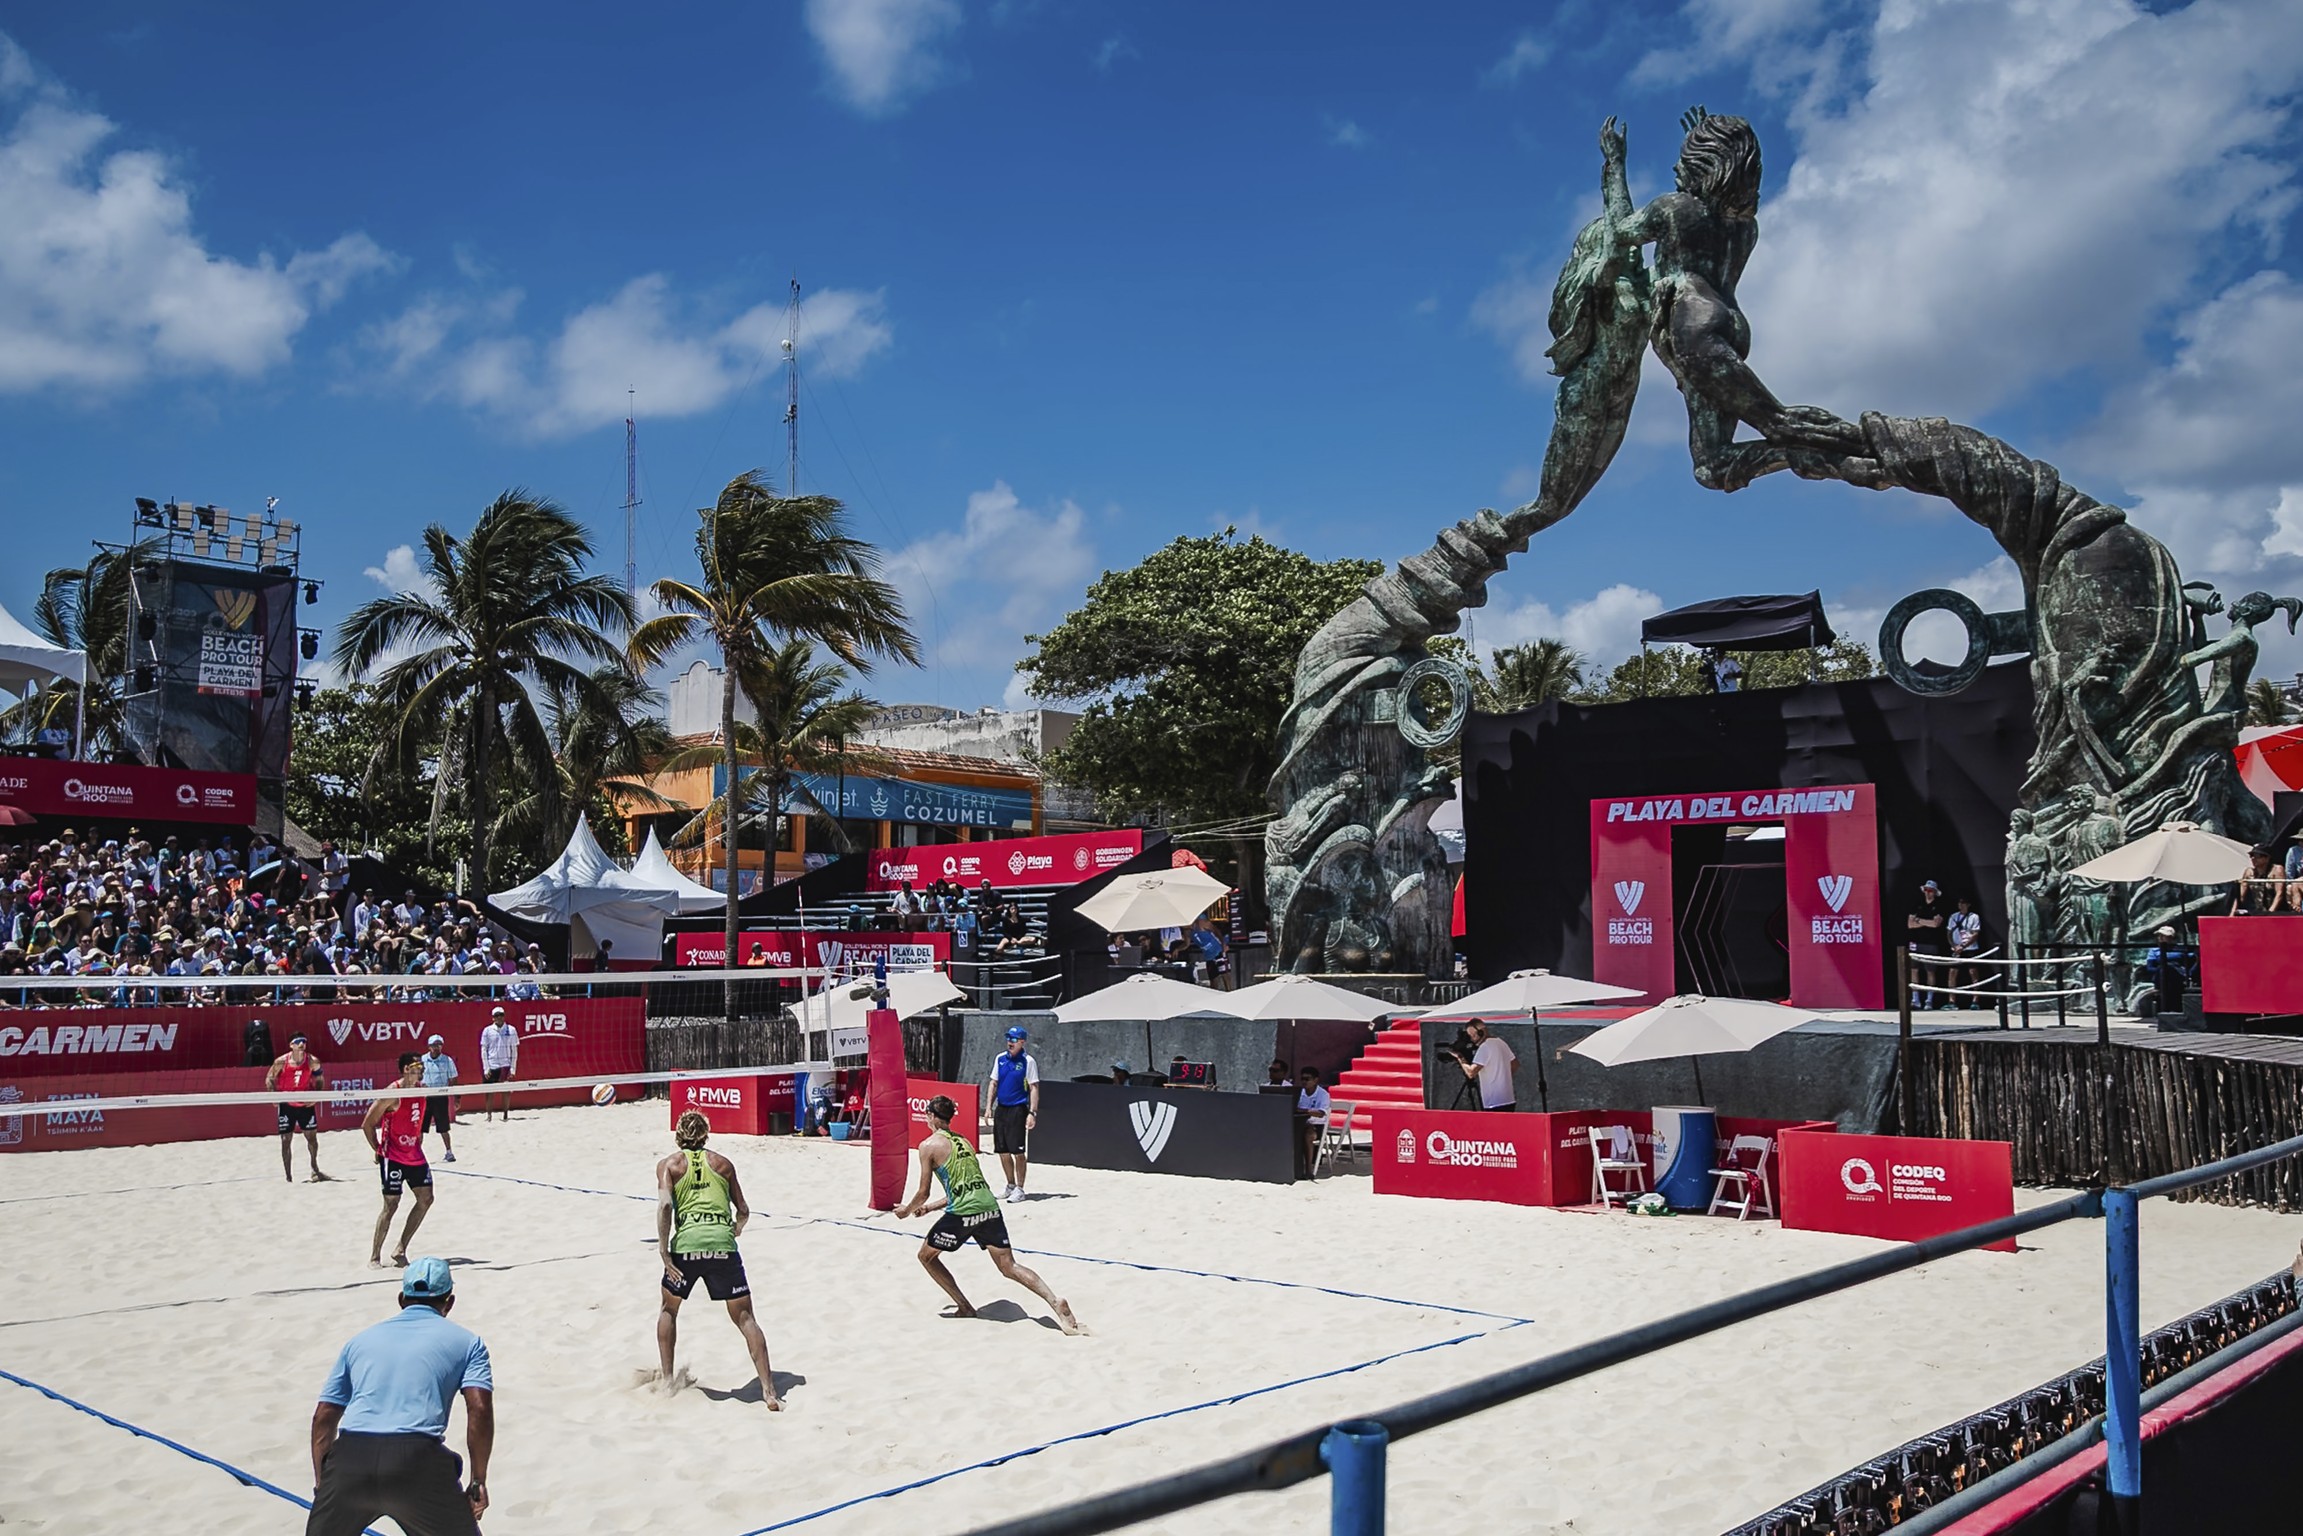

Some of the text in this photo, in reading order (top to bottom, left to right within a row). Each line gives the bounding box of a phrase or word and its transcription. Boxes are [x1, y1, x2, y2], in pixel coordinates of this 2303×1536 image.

[202, 635, 263, 655] BEACH
[201, 651, 262, 666] PRO TOUR
[203, 666, 258, 679] PLAYA DEL
[207, 676, 252, 687] CARMEN
[871, 707, 923, 730] PASEO
[64, 778, 133, 800] QUINTANA
[204, 788, 234, 798] CODEQ
[83, 793, 108, 803] ROO
[903, 789, 998, 809] FAST FERRY
[1607, 790, 1855, 823] PLAYA DEL CARMEN
[903, 805, 998, 826] COZUMEL
[1027, 855, 1053, 870] Playa
[1609, 922, 1653, 935] BEACH
[1812, 920, 1863, 934] BEACH
[1609, 935, 1653, 945] PRO TOUR
[1812, 934, 1863, 944] PRO TOUR
[698, 950, 726, 961] CONAD
[893, 947, 931, 957] PLAYA DEL
[525, 1013, 567, 1032] FIVB
[358, 1022, 425, 1041] VBTV
[0, 1023, 178, 1057] CARMEN
[847, 1036, 867, 1046] VBTV
[699, 1087, 742, 1104] FMVB
[46, 1108, 104, 1126] MAYA
[411, 1109, 421, 1122] 2
[955, 1142, 965, 1152] 2
[1426, 1130, 1517, 1160] QUINTANA
[1560, 1138, 1572, 1148] DEL
[1450, 1153, 1483, 1167] ROO
[694, 1168, 702, 1182] 1
[1891, 1165, 1946, 1182] CODEQ
[1903, 1193, 1936, 1201] QUINTANA
[1906, 1186, 1936, 1194] DEPORTE
